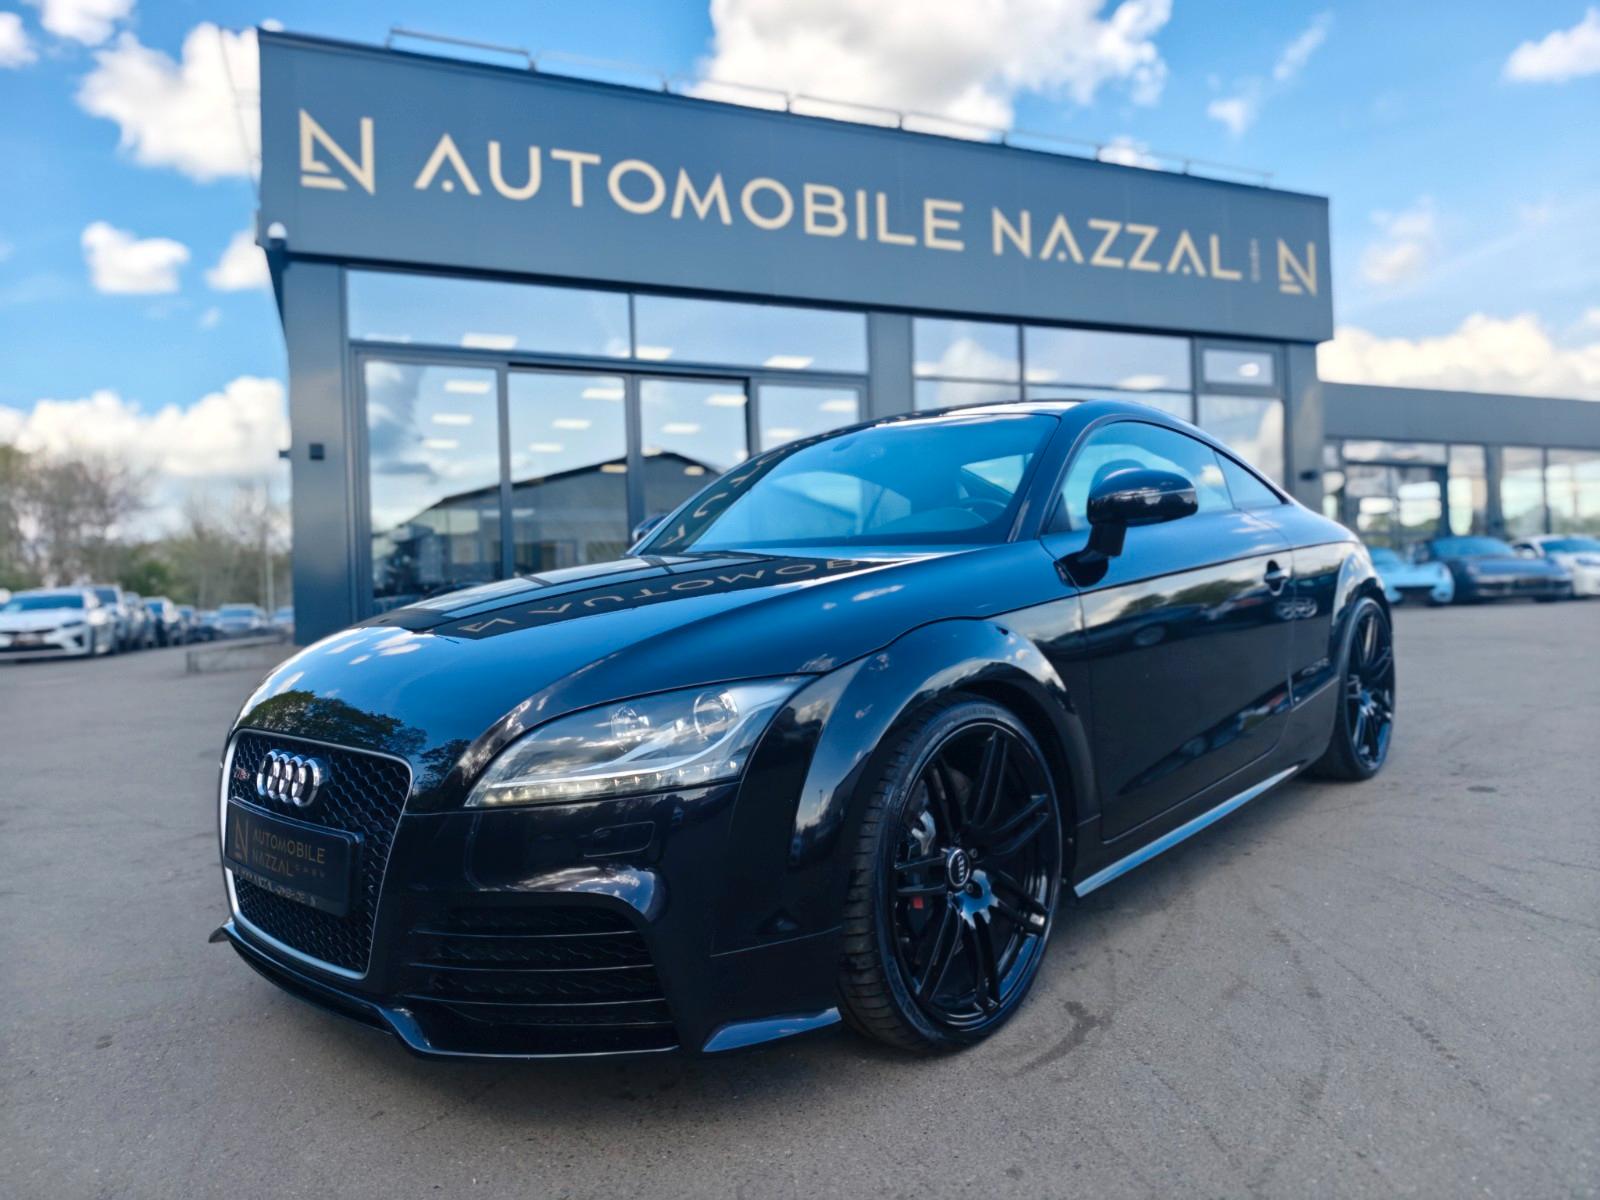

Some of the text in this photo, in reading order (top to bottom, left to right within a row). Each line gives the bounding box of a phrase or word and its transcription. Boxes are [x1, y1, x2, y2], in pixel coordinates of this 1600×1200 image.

[413, 132, 965, 252] AUTOMOBILE
[992, 206, 1243, 282] NAZZAL
[252, 828, 327, 865] AUTOMOBILE
